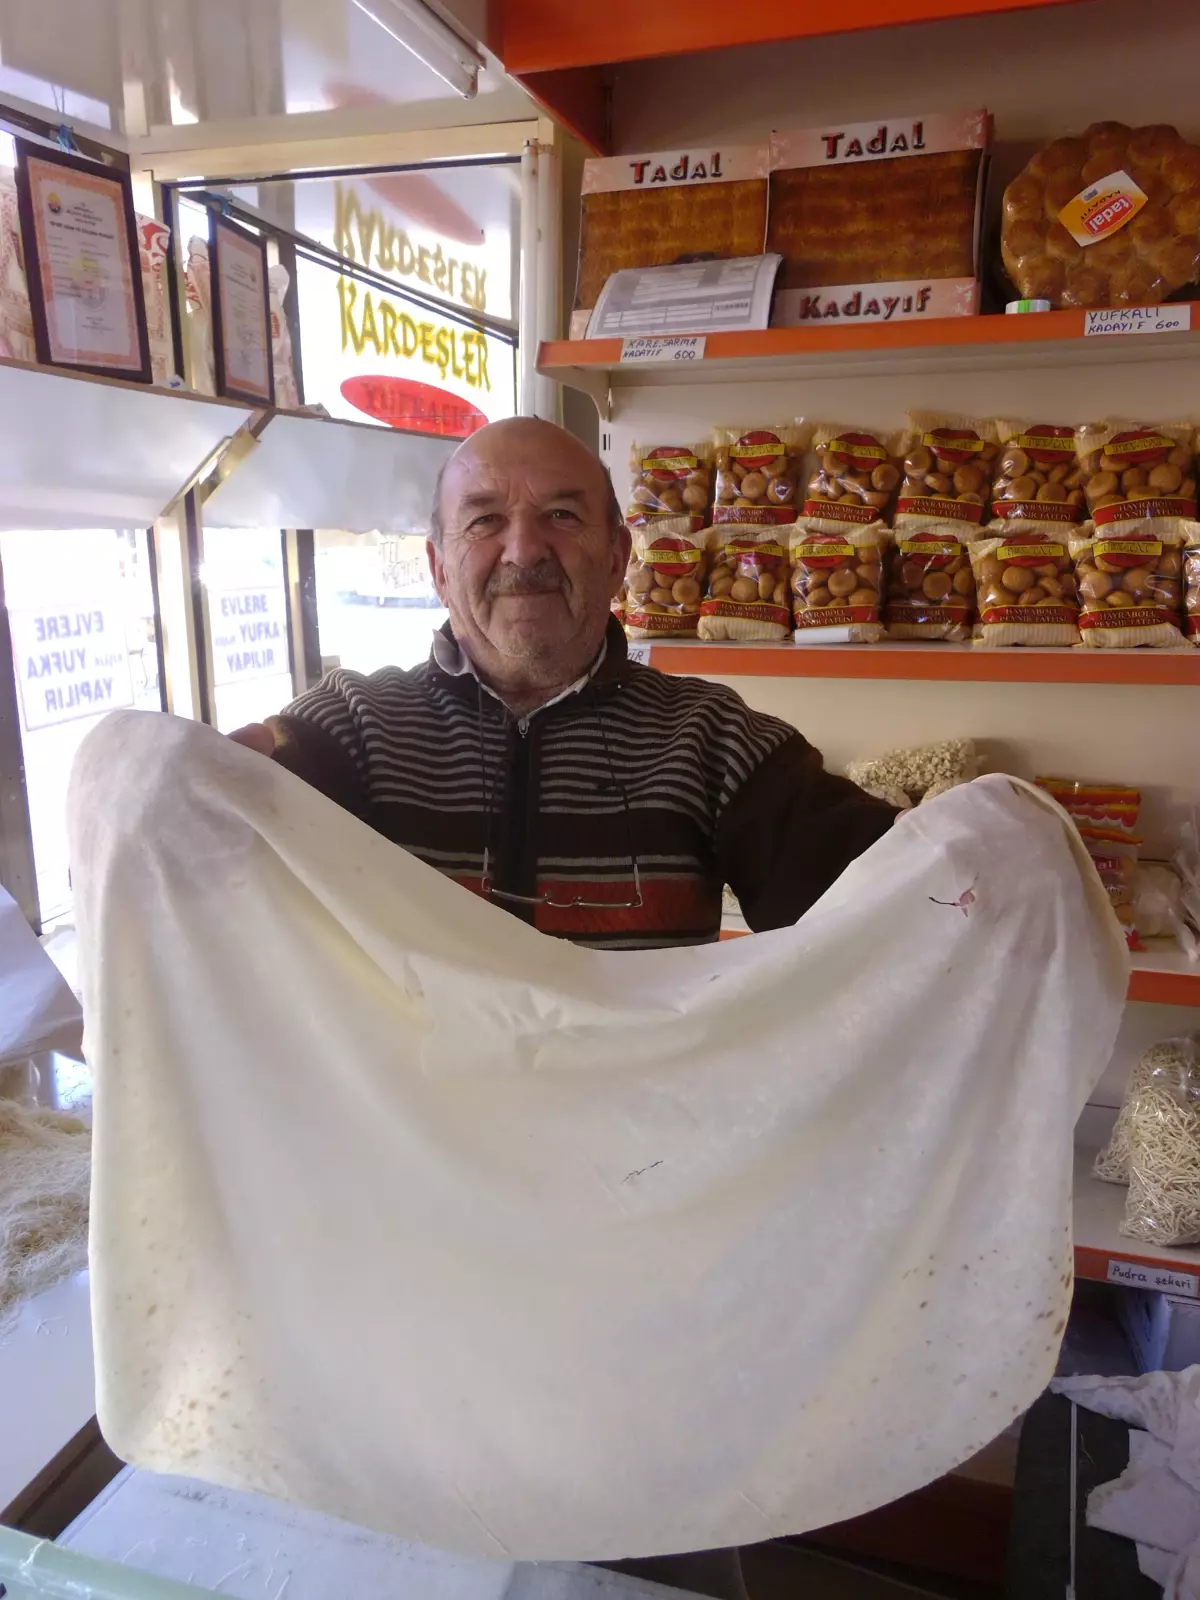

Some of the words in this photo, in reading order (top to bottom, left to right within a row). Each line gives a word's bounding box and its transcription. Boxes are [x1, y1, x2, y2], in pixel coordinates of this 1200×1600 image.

[821, 121, 926, 159] Tadal
[630, 152, 723, 184] Tadal
[1088, 197, 1131, 233] tadal
[1088, 307, 1159, 324] YUFKALI
[337, 273, 491, 392] KARDEŞLER
[1088, 321, 1146, 334] KADAYIF
[1155, 320, 1180, 330] 600
[674, 350, 696, 360] 600
[239, 621, 280, 643] YUFKA
[1112, 1265, 1147, 1282] Pudra
